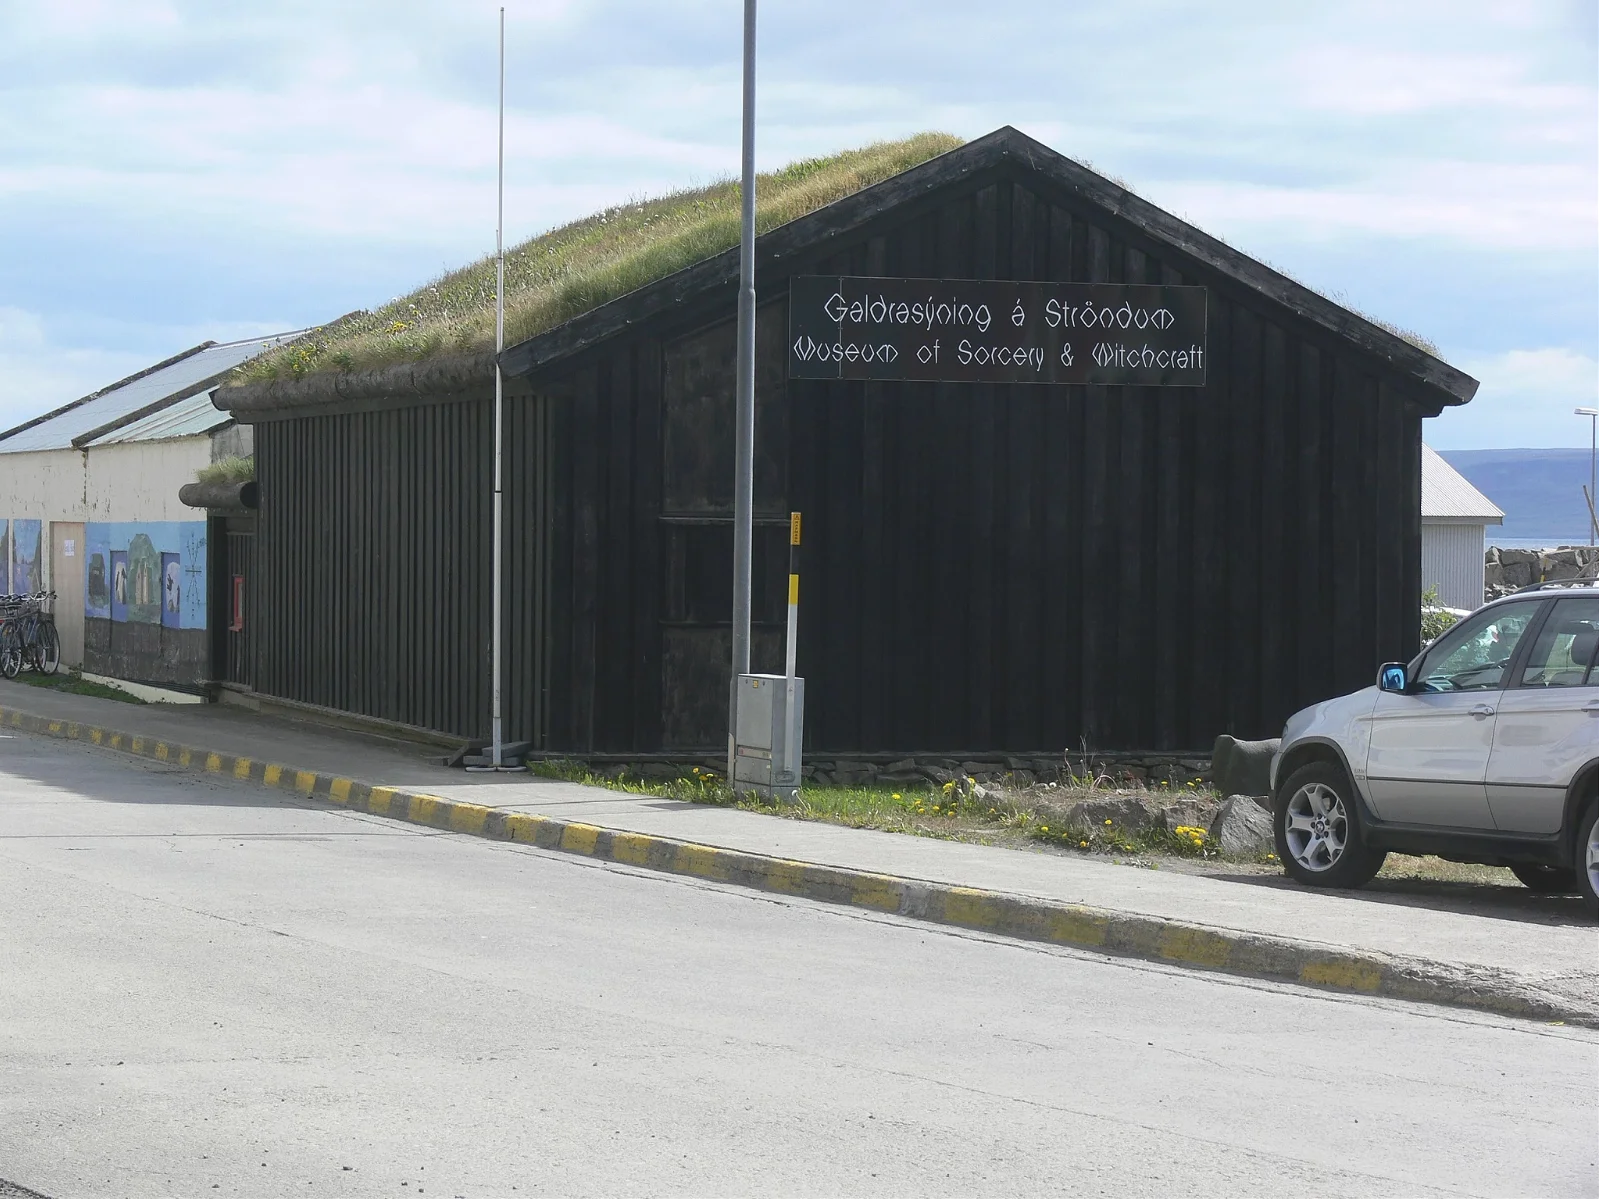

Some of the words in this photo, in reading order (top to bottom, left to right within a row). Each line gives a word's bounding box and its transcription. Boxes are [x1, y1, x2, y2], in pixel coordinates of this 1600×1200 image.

[824, 292, 992, 333] Galdrasýning
[1011, 298, 1026, 327] á
[1044, 298, 1175, 330] Ströndum
[793, 335, 899, 363] Museum
[916, 339, 941, 364] of
[957, 339, 1044, 372] Sorcery
[1060, 342, 1074, 367] &
[1091, 342, 1204, 369] Witchcraft
